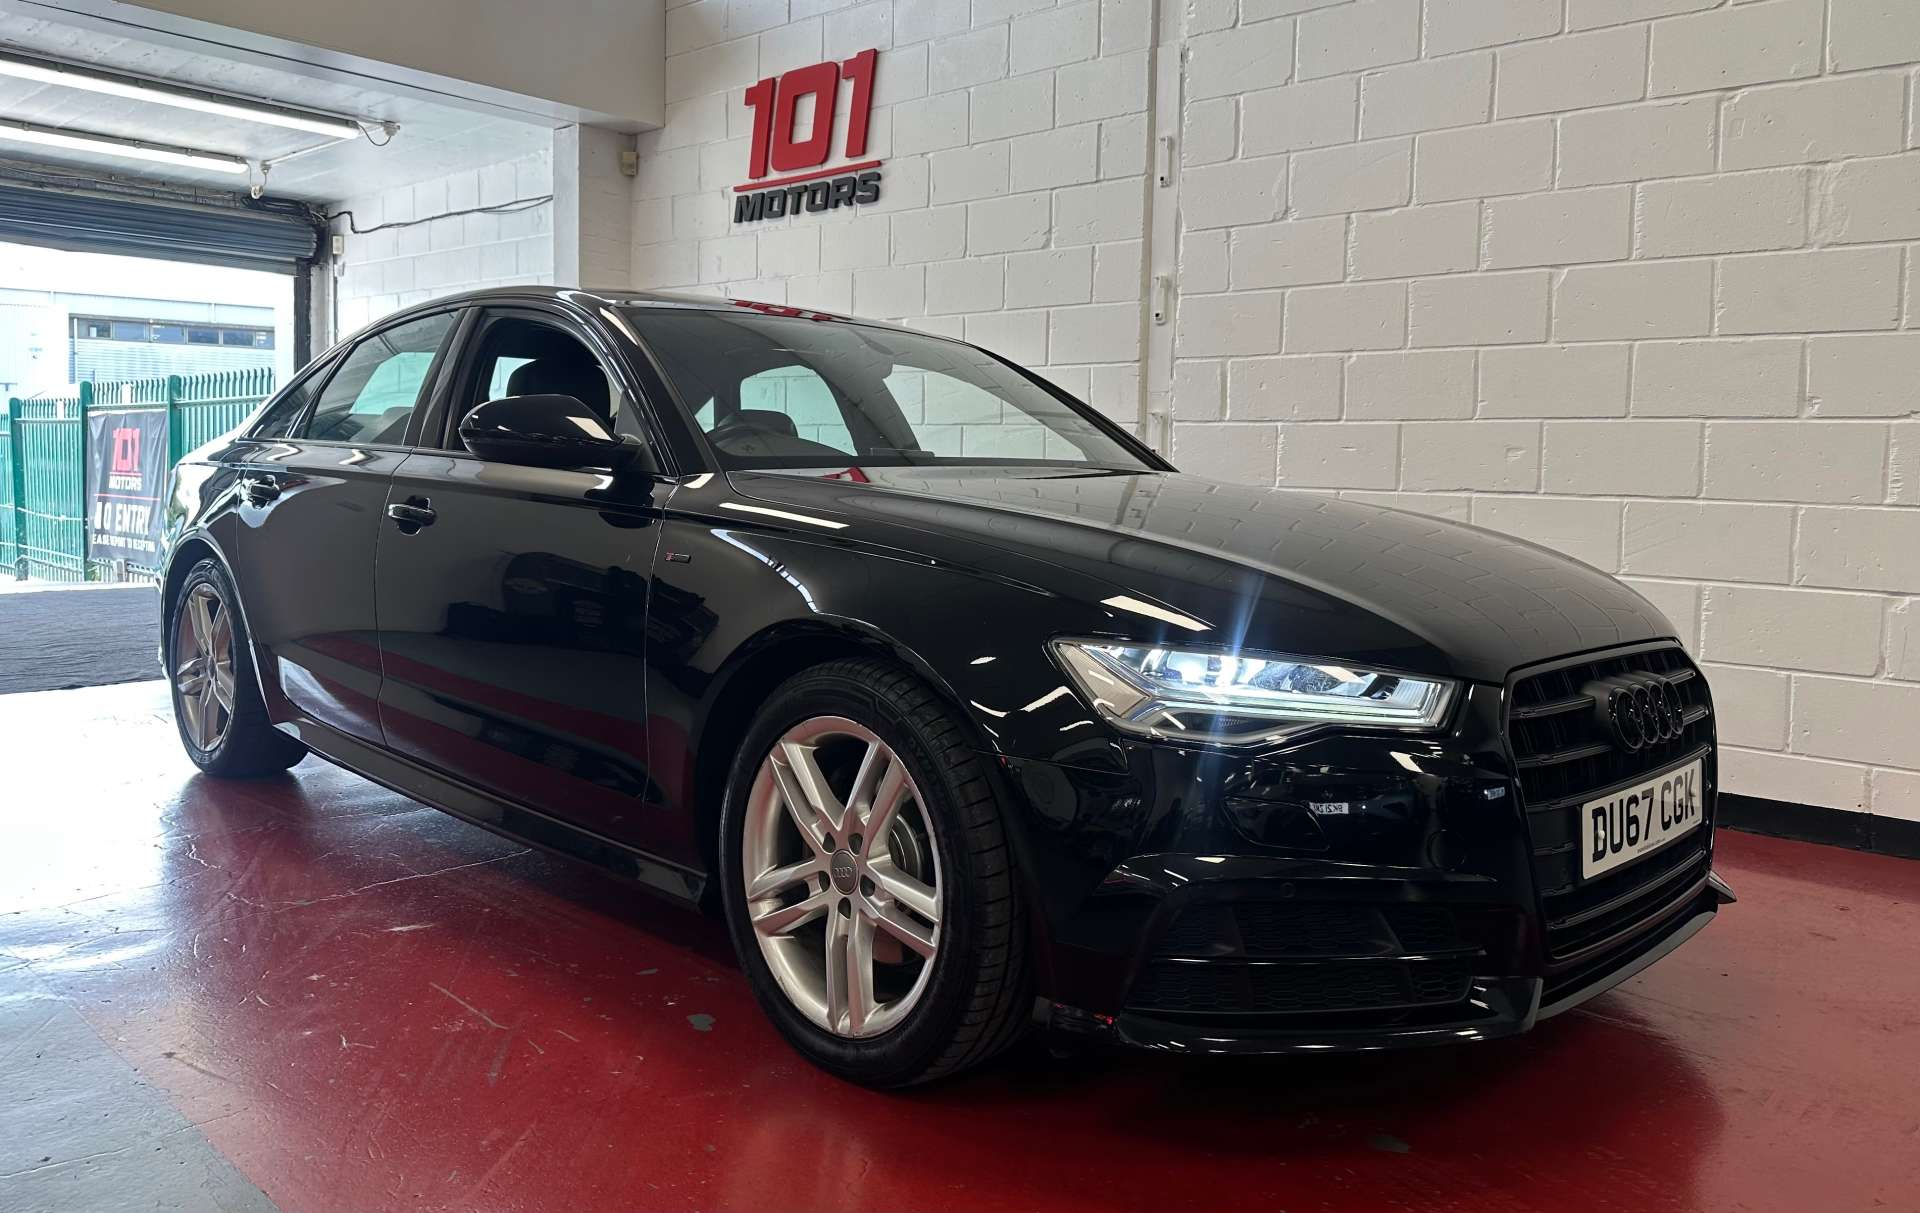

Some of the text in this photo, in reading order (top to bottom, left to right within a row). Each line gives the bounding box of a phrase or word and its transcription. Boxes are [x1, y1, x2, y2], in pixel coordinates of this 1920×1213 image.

[744, 48, 878, 180] 101
[733, 171, 882, 223] MOTORS
[112, 428, 141, 472] 101
[109, 476, 142, 491] MOTORS
[116, 504, 151, 535] ENTRY
[1591, 768, 1697, 863] DU67 CGK
